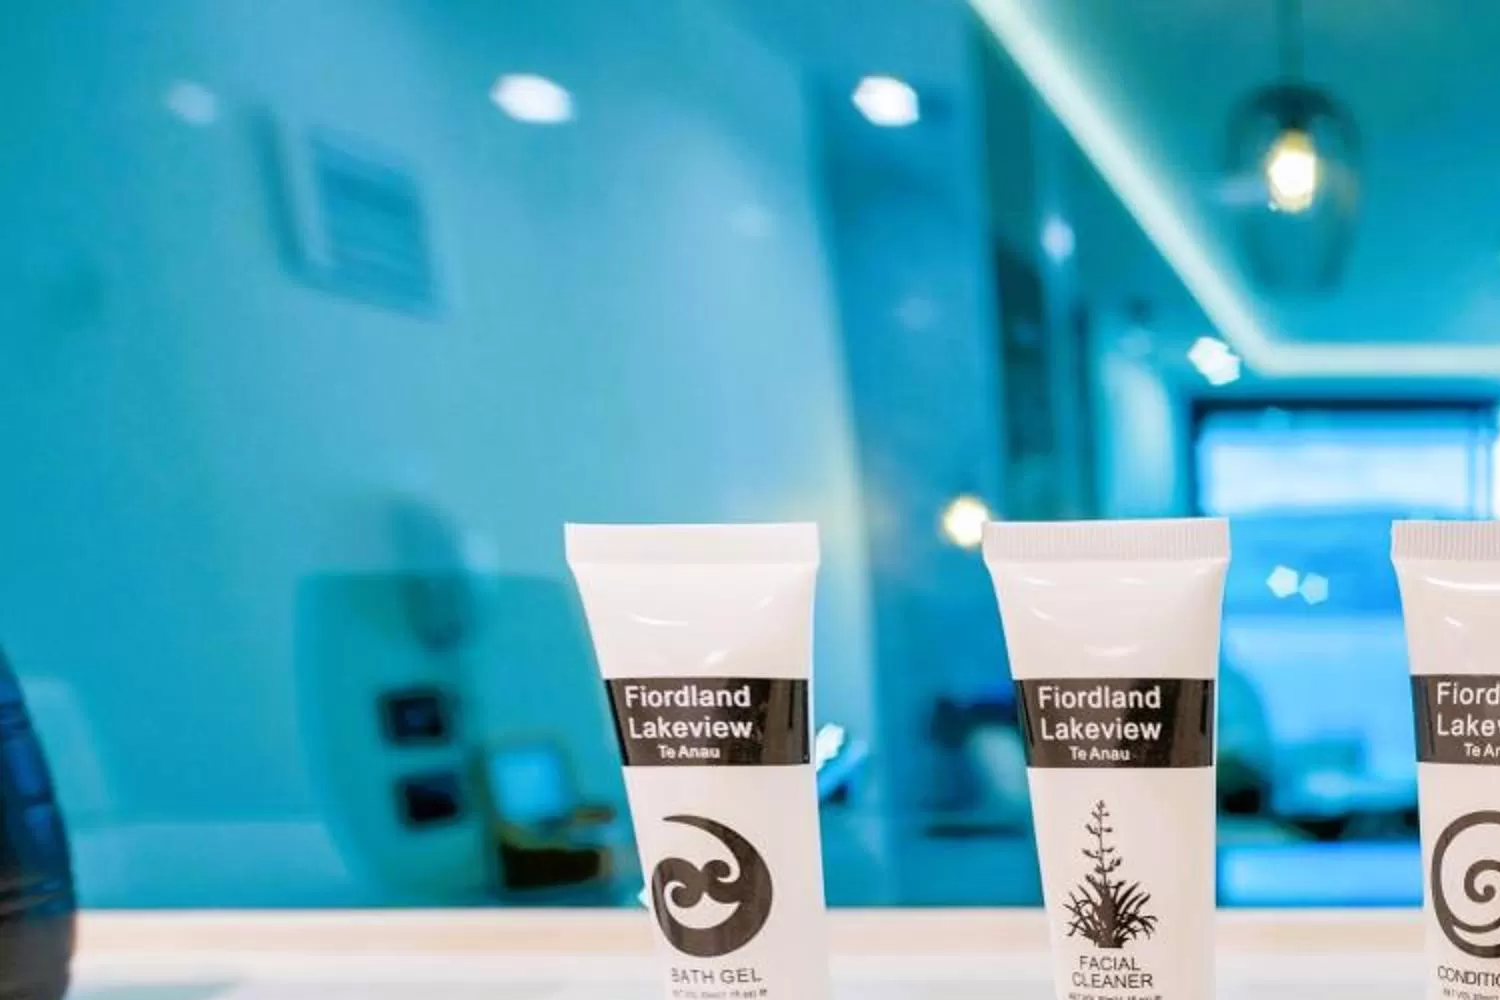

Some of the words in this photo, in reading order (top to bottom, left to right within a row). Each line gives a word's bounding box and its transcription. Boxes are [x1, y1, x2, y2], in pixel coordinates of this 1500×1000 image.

[624, 685, 752, 708] Fiordland
[1037, 685, 1161, 709] Fiordland
[628, 716, 753, 739] Lakeview
[1040, 717, 1162, 741] Lakeview
[656, 744, 676, 759] Te
[678, 745, 721, 759] Anau
[1068, 746, 1087, 761] Te
[1089, 746, 1131, 761] Anau
[1463, 742, 1481, 757] Te
[1079, 955, 1141, 971] FACIAL
[670, 967, 714, 984] BATH
[719, 968, 763, 984] GEL
[1071, 971, 1154, 989] CLEANER
